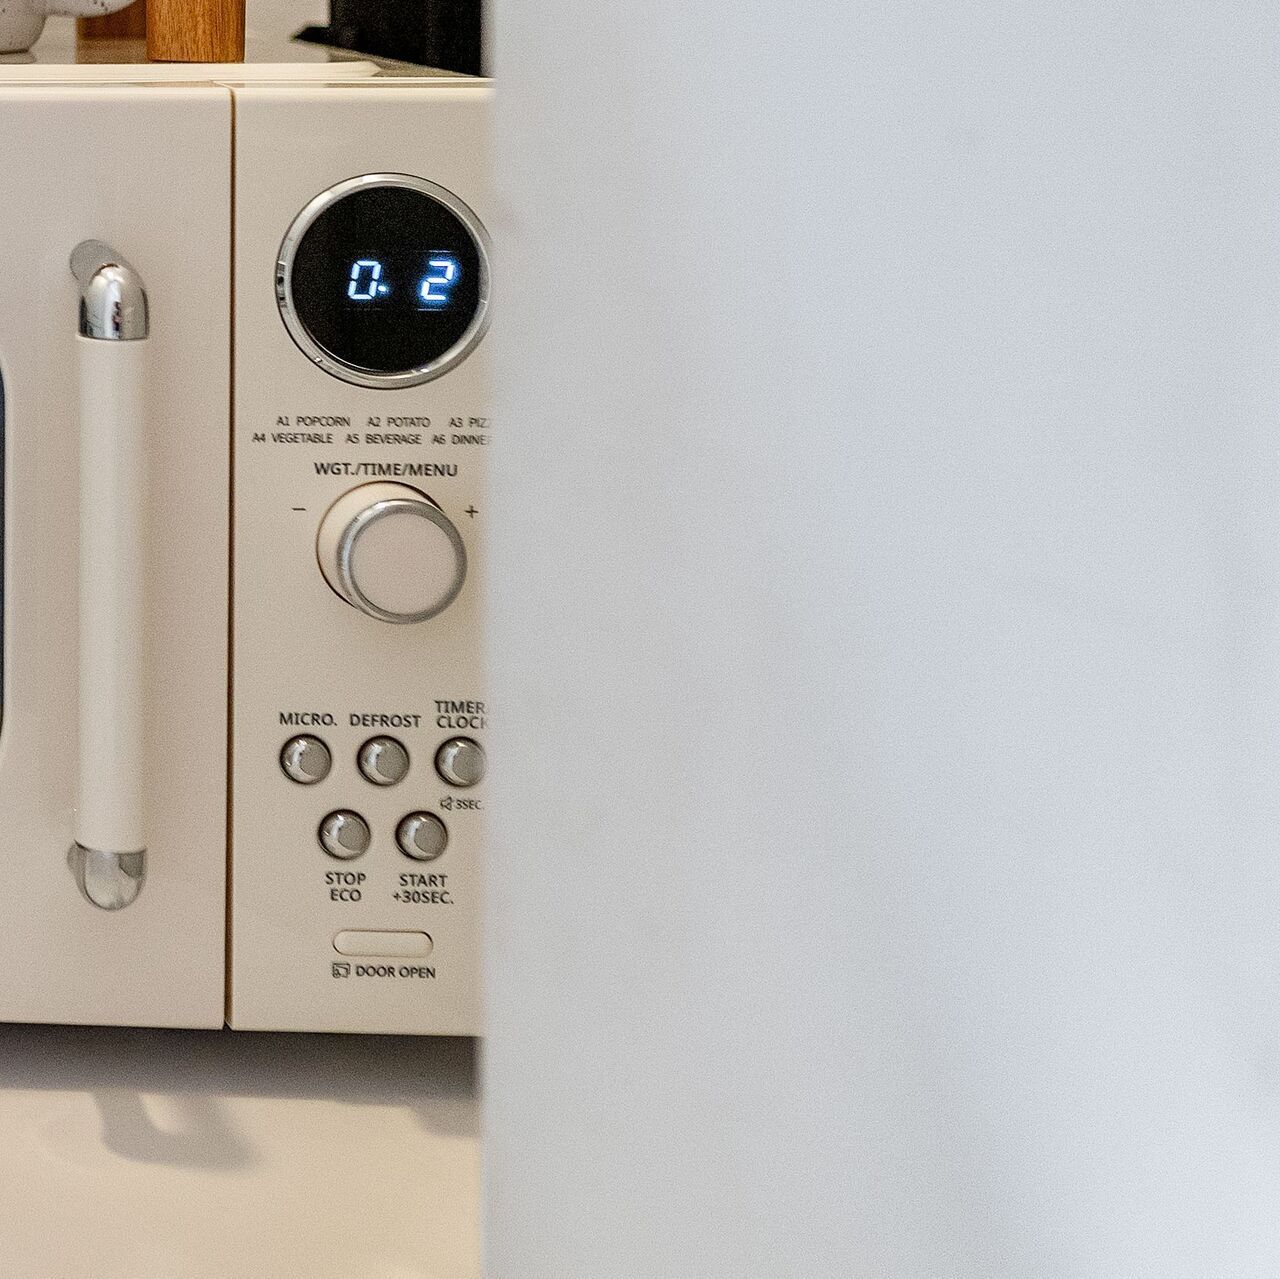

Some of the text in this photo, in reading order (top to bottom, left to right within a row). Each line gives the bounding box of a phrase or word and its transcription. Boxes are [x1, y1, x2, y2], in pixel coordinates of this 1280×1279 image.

[276, 416, 493, 429] A1 POPCORN A2 POTATO A3 PIZ
[251, 433, 266, 443] A4
[271, 433, 334, 444] VEGETABLE
[344, 434, 360, 444] A5
[366, 434, 422, 445] BEVERAGE
[431, 434, 446, 445] A6
[314, 462, 458, 477] WGT./TIME/MENU
[434, 700, 486, 714] TIMER
[279, 712, 338, 726] MICRO.
[349, 713, 422, 728] DEFROST
[325, 872, 367, 886] STOP
[399, 873, 448, 888] START
[330, 888, 362, 902] ECO
[393, 890, 454, 905] +30SEC.
[355, 966, 436, 979] DOOR OPEN
